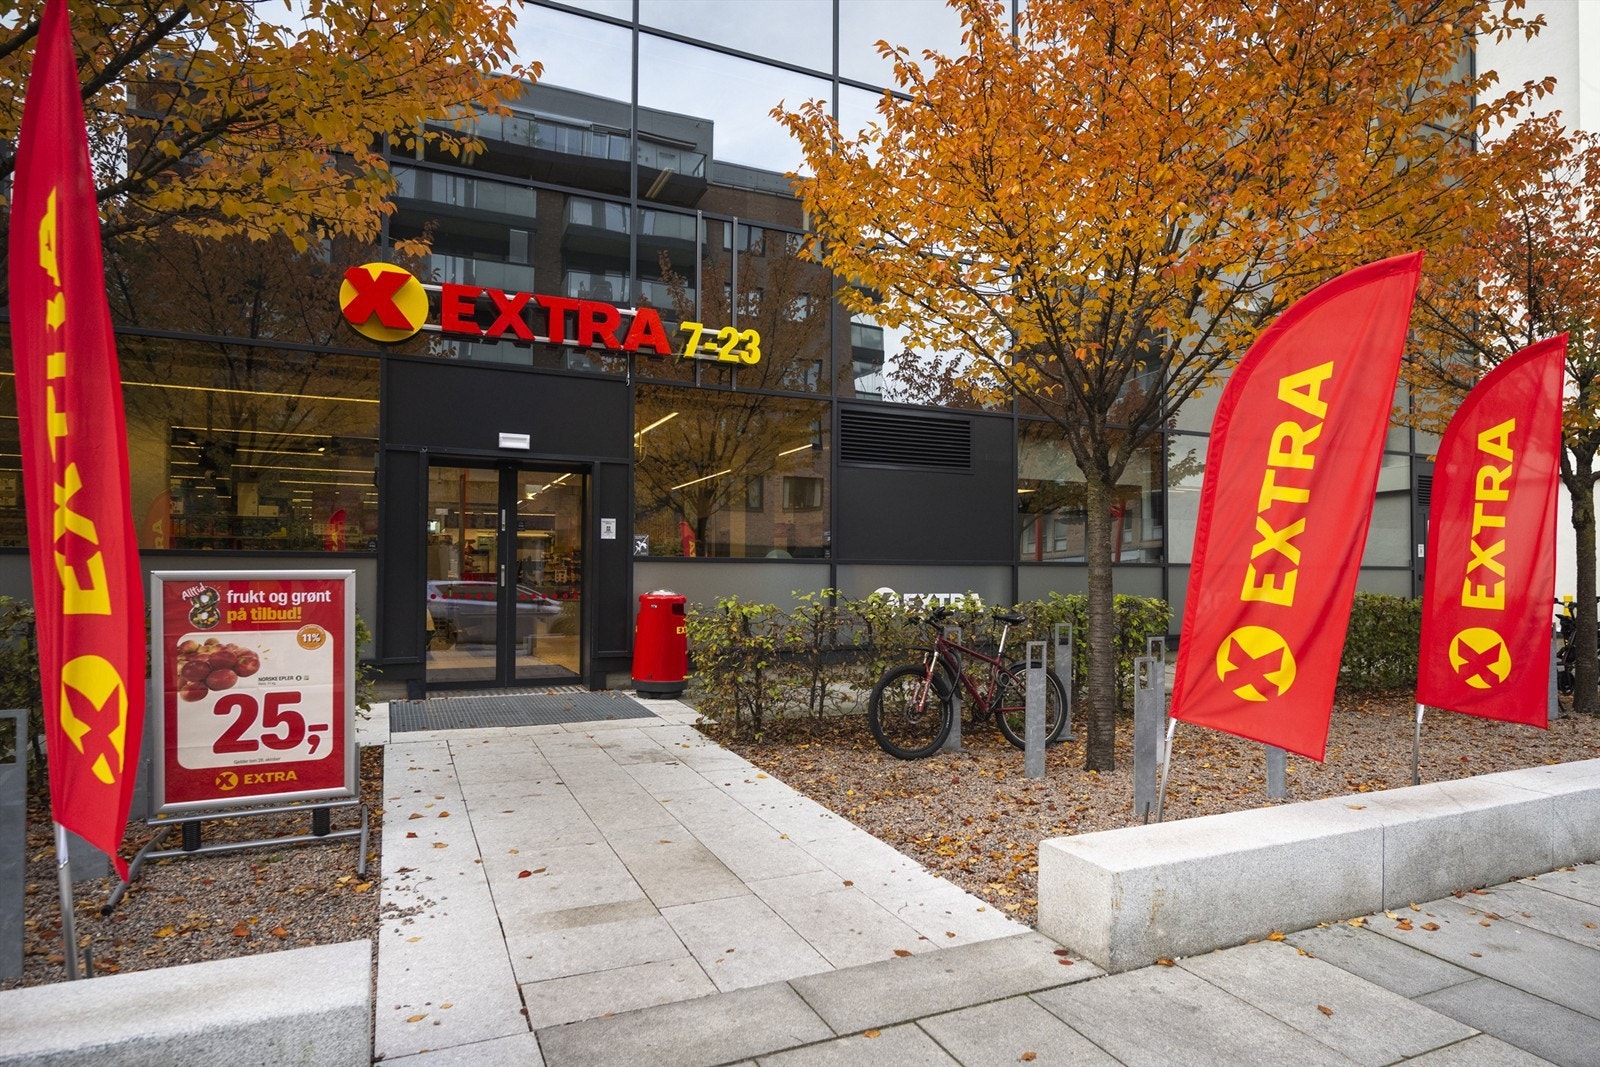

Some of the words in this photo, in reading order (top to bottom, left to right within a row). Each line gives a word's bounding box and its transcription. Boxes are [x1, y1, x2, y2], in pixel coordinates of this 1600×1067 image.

[441, 282, 672, 355] EXTRA
[680, 320, 762, 365] 7-23
[1240, 360, 1334, 607] EXTRA
[1461, 417, 1516, 611] EXTRA
[181, 582, 207, 601] Alltid
[226, 589, 266, 604] frukt
[268, 592, 288, 606] og
[291, 590, 332, 606] grønt
[226, 607, 248, 624] på
[250, 606, 302, 621] tilbud!
[302, 633, 321, 643] 11%
[243, 770, 298, 785] EXTRA
